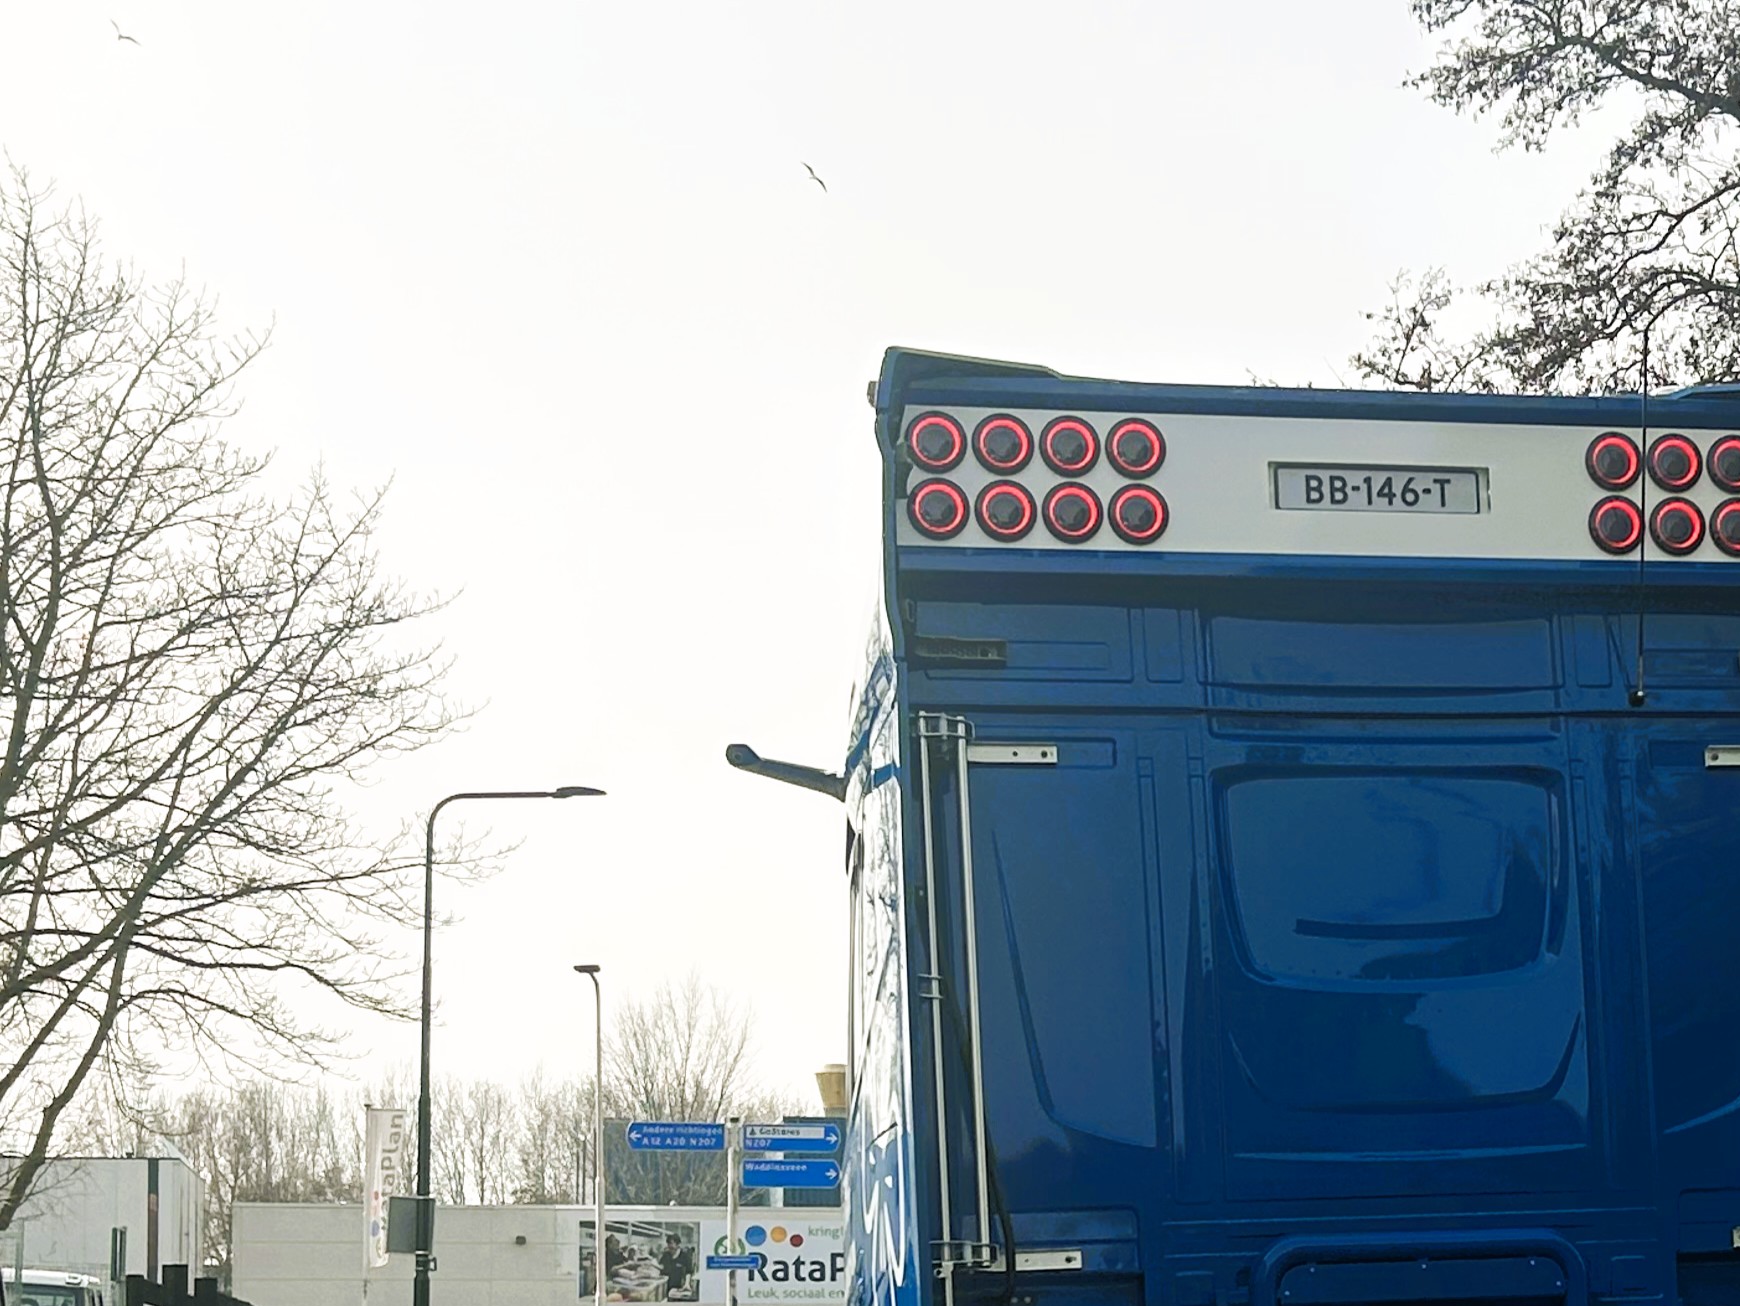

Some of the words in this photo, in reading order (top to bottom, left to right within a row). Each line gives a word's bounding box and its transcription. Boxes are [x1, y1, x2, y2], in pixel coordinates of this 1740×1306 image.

[1305, 474, 1451, 507] BB-146-T
[689, 1137, 717, 1147] N207
[744, 1139, 772, 1148] N207
[748, 1287, 780, 1299] Leuk,
[783, 1286, 826, 1298] sociaal
